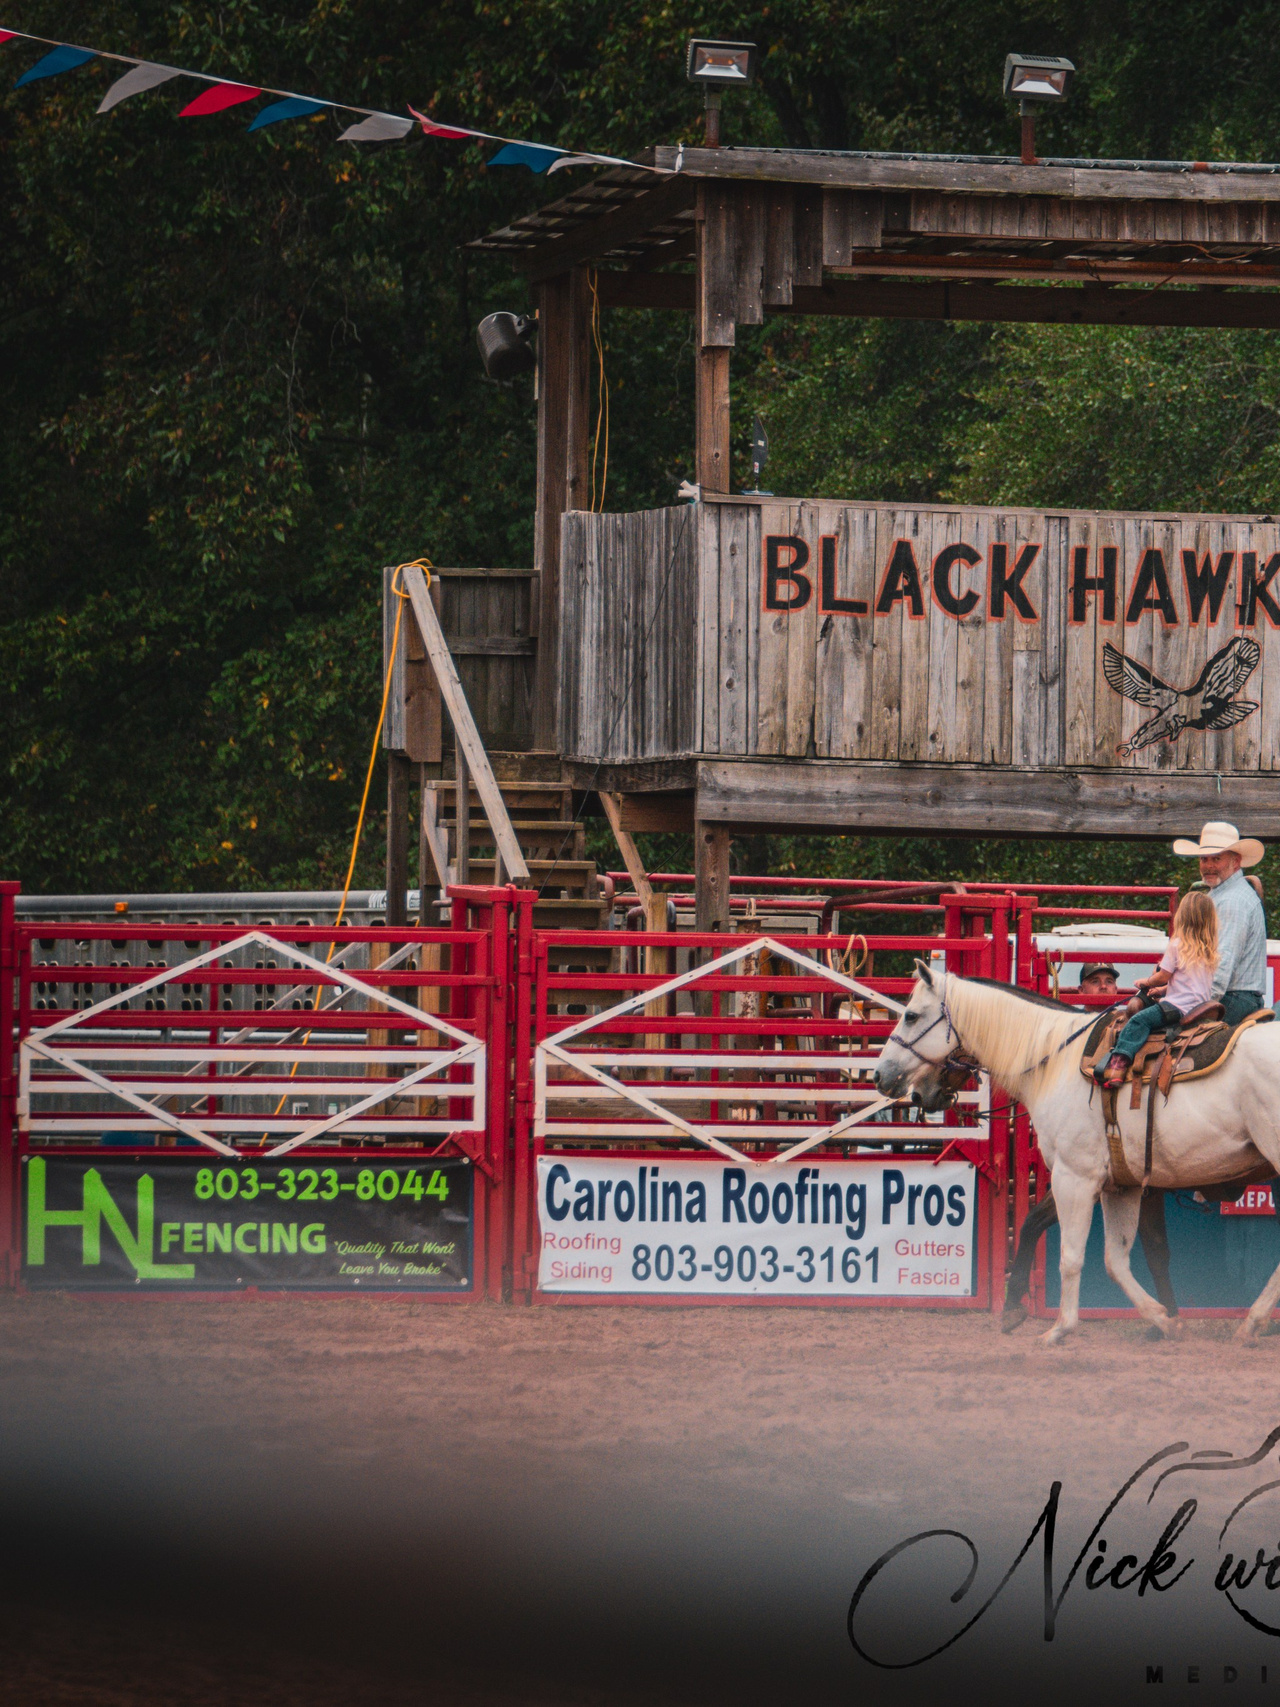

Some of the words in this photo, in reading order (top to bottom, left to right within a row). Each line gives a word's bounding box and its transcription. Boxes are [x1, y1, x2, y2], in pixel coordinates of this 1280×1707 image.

[761, 533, 1043, 625] BLACK
[194, 1167, 450, 1202] 803-323-8044
[545, 1163, 707, 1223] Carolina
[721, 1167, 867, 1241] Roofing
[881, 1168, 967, 1227] Pros
[161, 1222, 327, 1255] FENCING
[390, 1241, 419, 1254] That
[422, 1241, 456, 1254] Won't
[543, 1231, 622, 1254] Roofing
[894, 1238, 966, 1258] Gutters
[339, 1261, 375, 1275] Leave
[378, 1261, 400, 1275] You
[551, 1261, 613, 1283] Siding
[631, 1243, 880, 1284] 803-903-3161
[897, 1267, 960, 1286] Fascia
